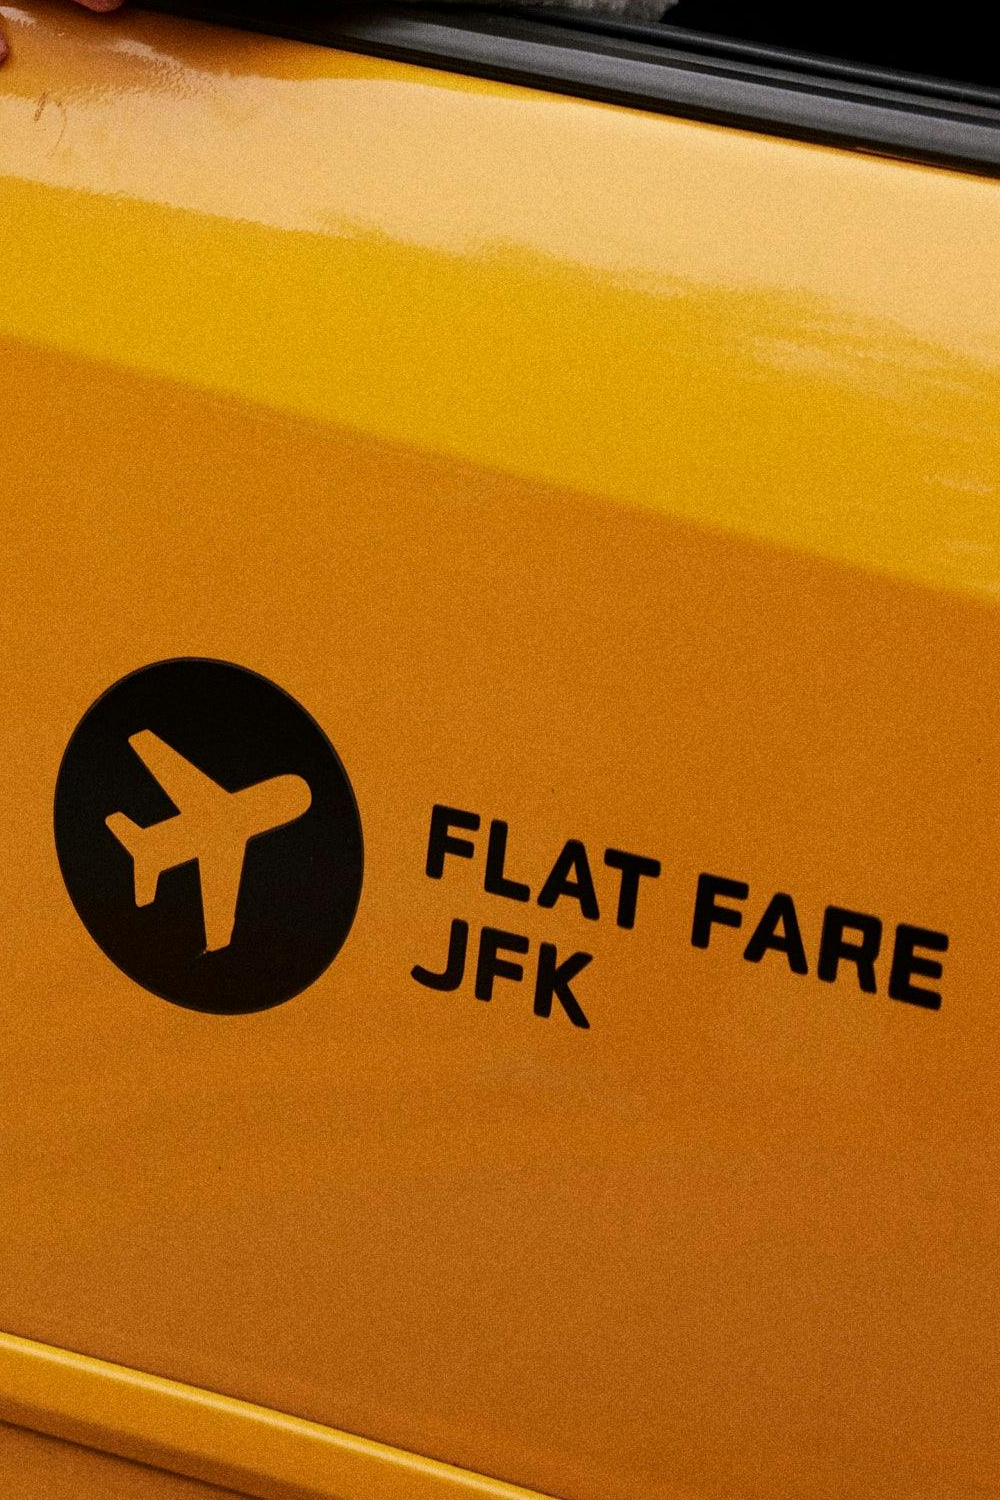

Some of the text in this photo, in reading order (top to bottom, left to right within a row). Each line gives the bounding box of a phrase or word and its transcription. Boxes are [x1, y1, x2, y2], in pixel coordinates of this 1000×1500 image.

[410, 918, 593, 1030] JFK
[425, 804, 950, 1011] FLAT FARE
